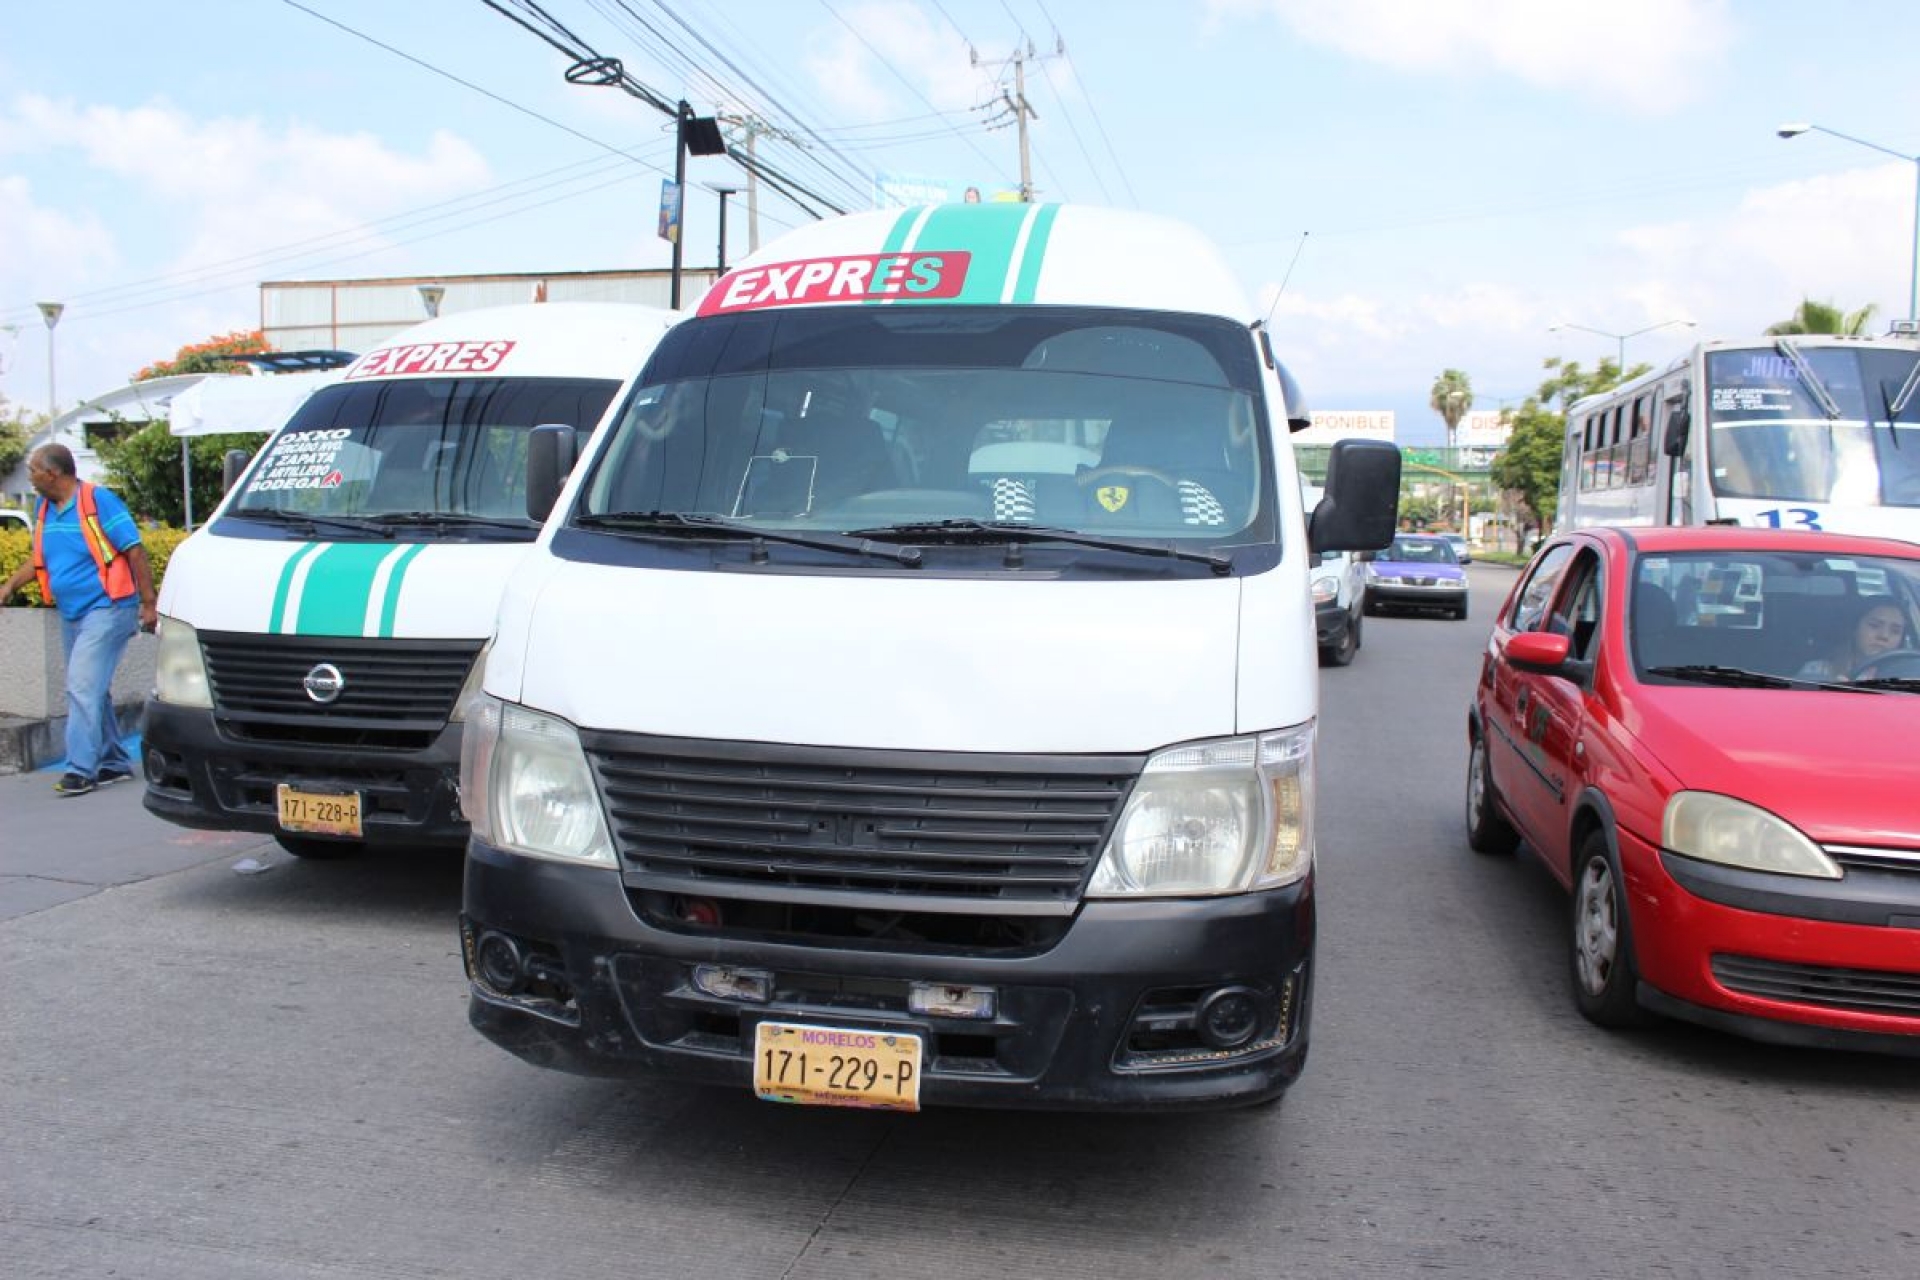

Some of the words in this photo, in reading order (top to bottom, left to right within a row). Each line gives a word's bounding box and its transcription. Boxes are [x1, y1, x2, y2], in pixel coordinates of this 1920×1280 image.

[720, 256, 944, 308] EXPRES
[350, 341, 507, 377] EXPRES
[1314, 415, 1389, 430] PONIBLE
[279, 428, 352, 443] OXXO
[275, 452, 337, 467] ZAPATA
[267, 464, 331, 479] ARTILLERO
[247, 476, 321, 493] BODEGA
[1756, 509, 1822, 531] 13
[284, 798, 359, 824] 171-228-P
[801, 1030, 876, 1049] MORELOS
[764, 1048, 914, 1097] 171-229-P
